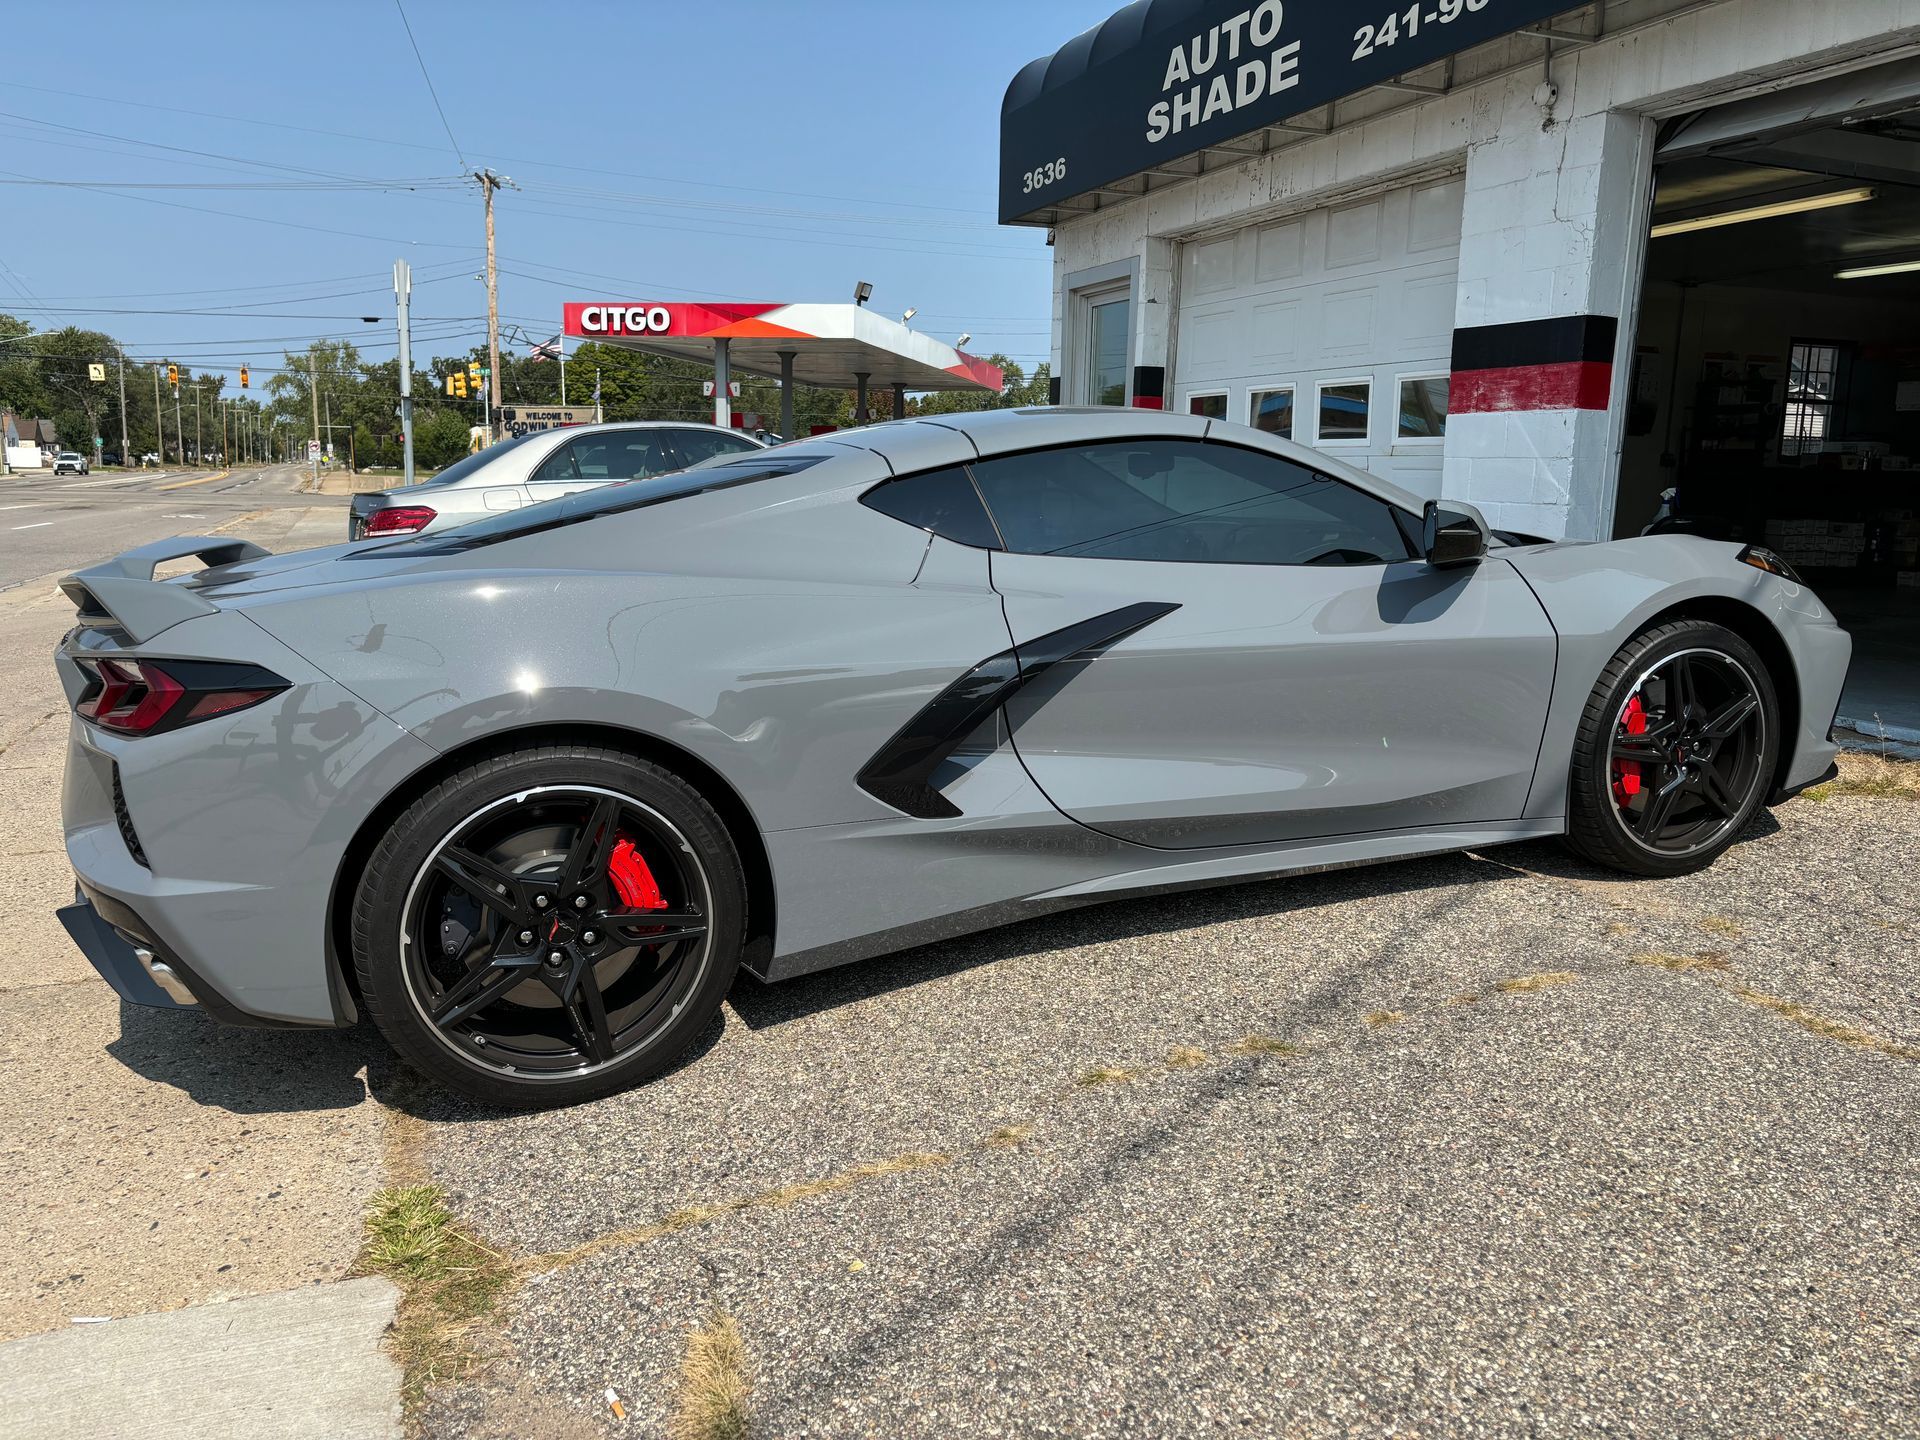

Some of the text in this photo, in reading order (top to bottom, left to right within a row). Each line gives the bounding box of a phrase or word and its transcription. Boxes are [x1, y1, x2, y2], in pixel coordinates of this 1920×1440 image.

[1162, 0, 1284, 92] AUTO
[1145, 39, 1302, 144] SHADE
[1022, 157, 1067, 195] 3636
[581, 306, 671, 332] CITGO
[526, 412, 573, 421] WELCOME TO
